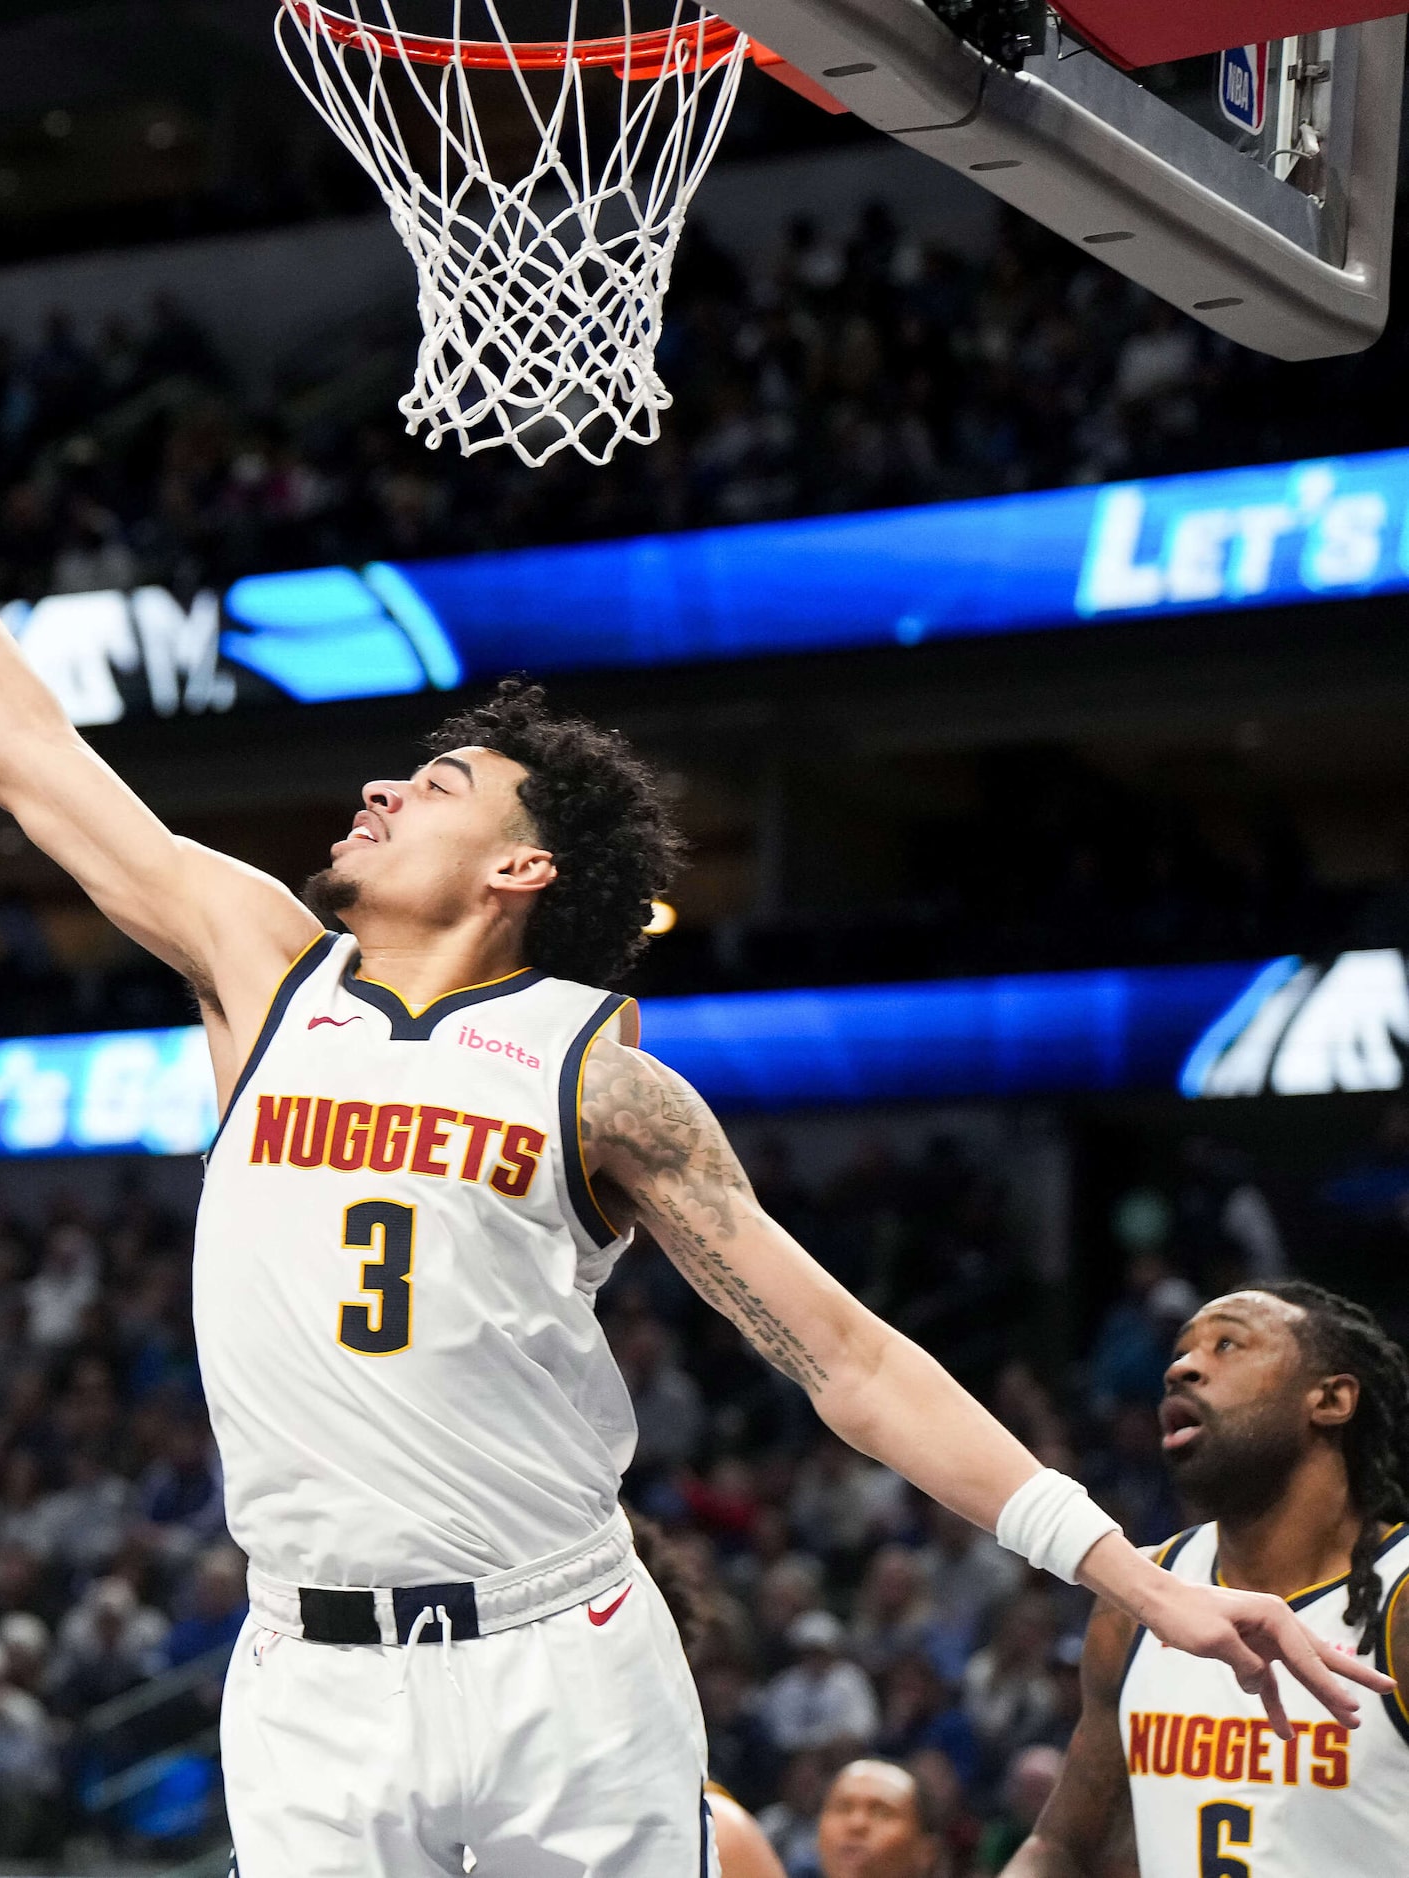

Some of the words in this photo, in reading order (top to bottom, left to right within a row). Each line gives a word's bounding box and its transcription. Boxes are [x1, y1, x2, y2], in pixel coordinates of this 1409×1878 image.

[1226, 61, 1250, 112] NBA
[458, 1025, 540, 1070] ibotta
[249, 1094, 548, 1199] NUGGETS
[337, 1197, 417, 1358] 3
[1128, 1711, 1351, 1790] NUGGETS
